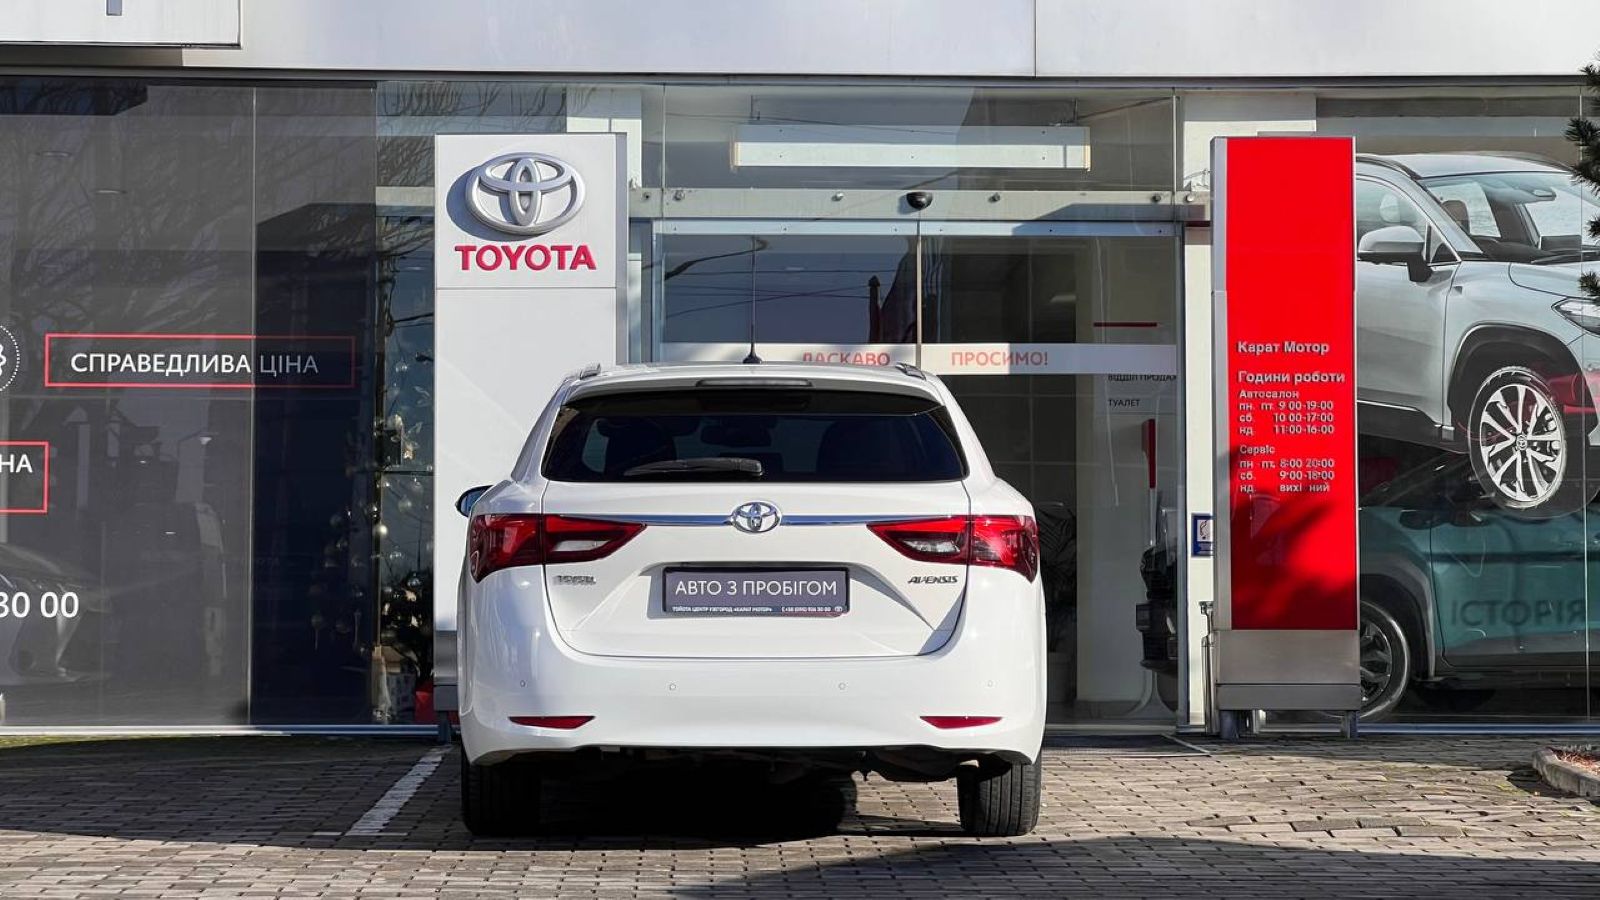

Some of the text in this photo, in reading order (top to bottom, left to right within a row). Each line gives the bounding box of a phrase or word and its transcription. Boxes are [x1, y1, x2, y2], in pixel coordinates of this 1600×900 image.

[454, 244, 597, 271] TOYOTA
[1237, 341, 1330, 355] Карат Мотор
[70, 353, 320, 377] СПРАВЕДЛИВА ЦІНА
[951, 352, 1049, 367] ПРОСИМО!
[1237, 370, 1346, 386] Години роботи
[1239, 389, 1300, 399] Автосалон
[1108, 399, 1140, 407] ТУАЛЕТ
[1239, 444, 1276, 456] Сервіс
[907, 575, 959, 585] AVENSIS
[675, 580, 722, 596] АВТО
[742, 580, 837, 596] ПРОБІГОМ
[40, 591, 80, 619] 00
[1451, 600, 1586, 627] ІСТОРІЯ
